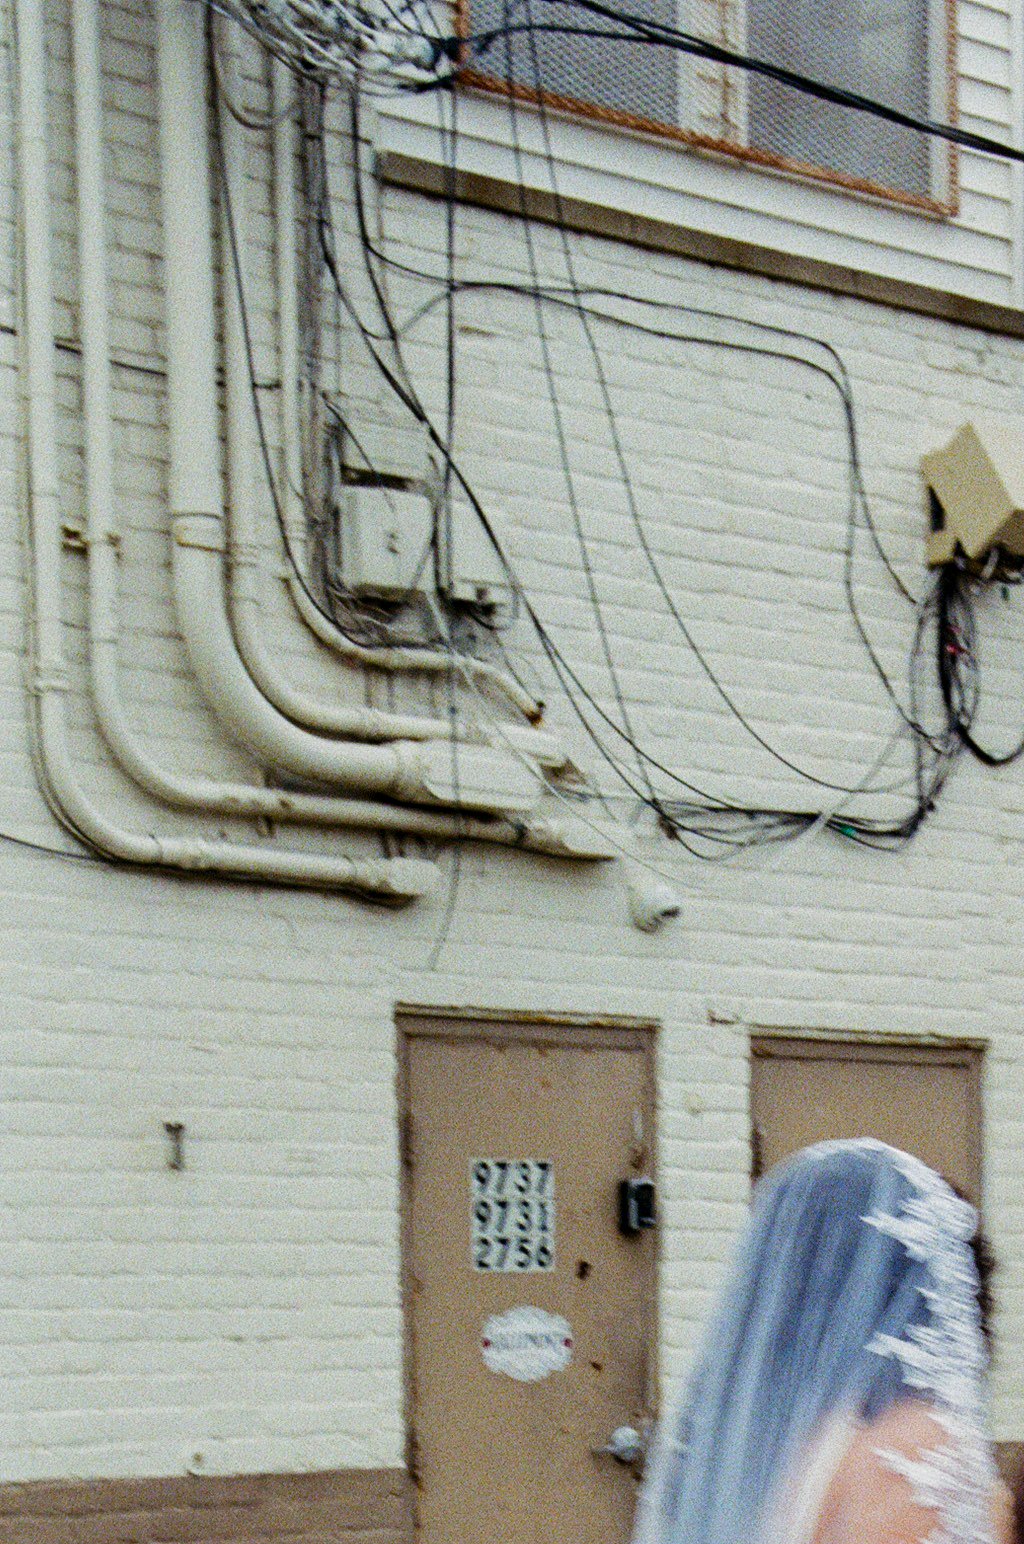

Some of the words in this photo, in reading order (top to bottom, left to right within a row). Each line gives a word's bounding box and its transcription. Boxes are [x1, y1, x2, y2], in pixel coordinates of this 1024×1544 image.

[473, 1160, 551, 1194] 9737
[473, 1199, 549, 1233] 9731
[474, 1236, 552, 1269] 2756
